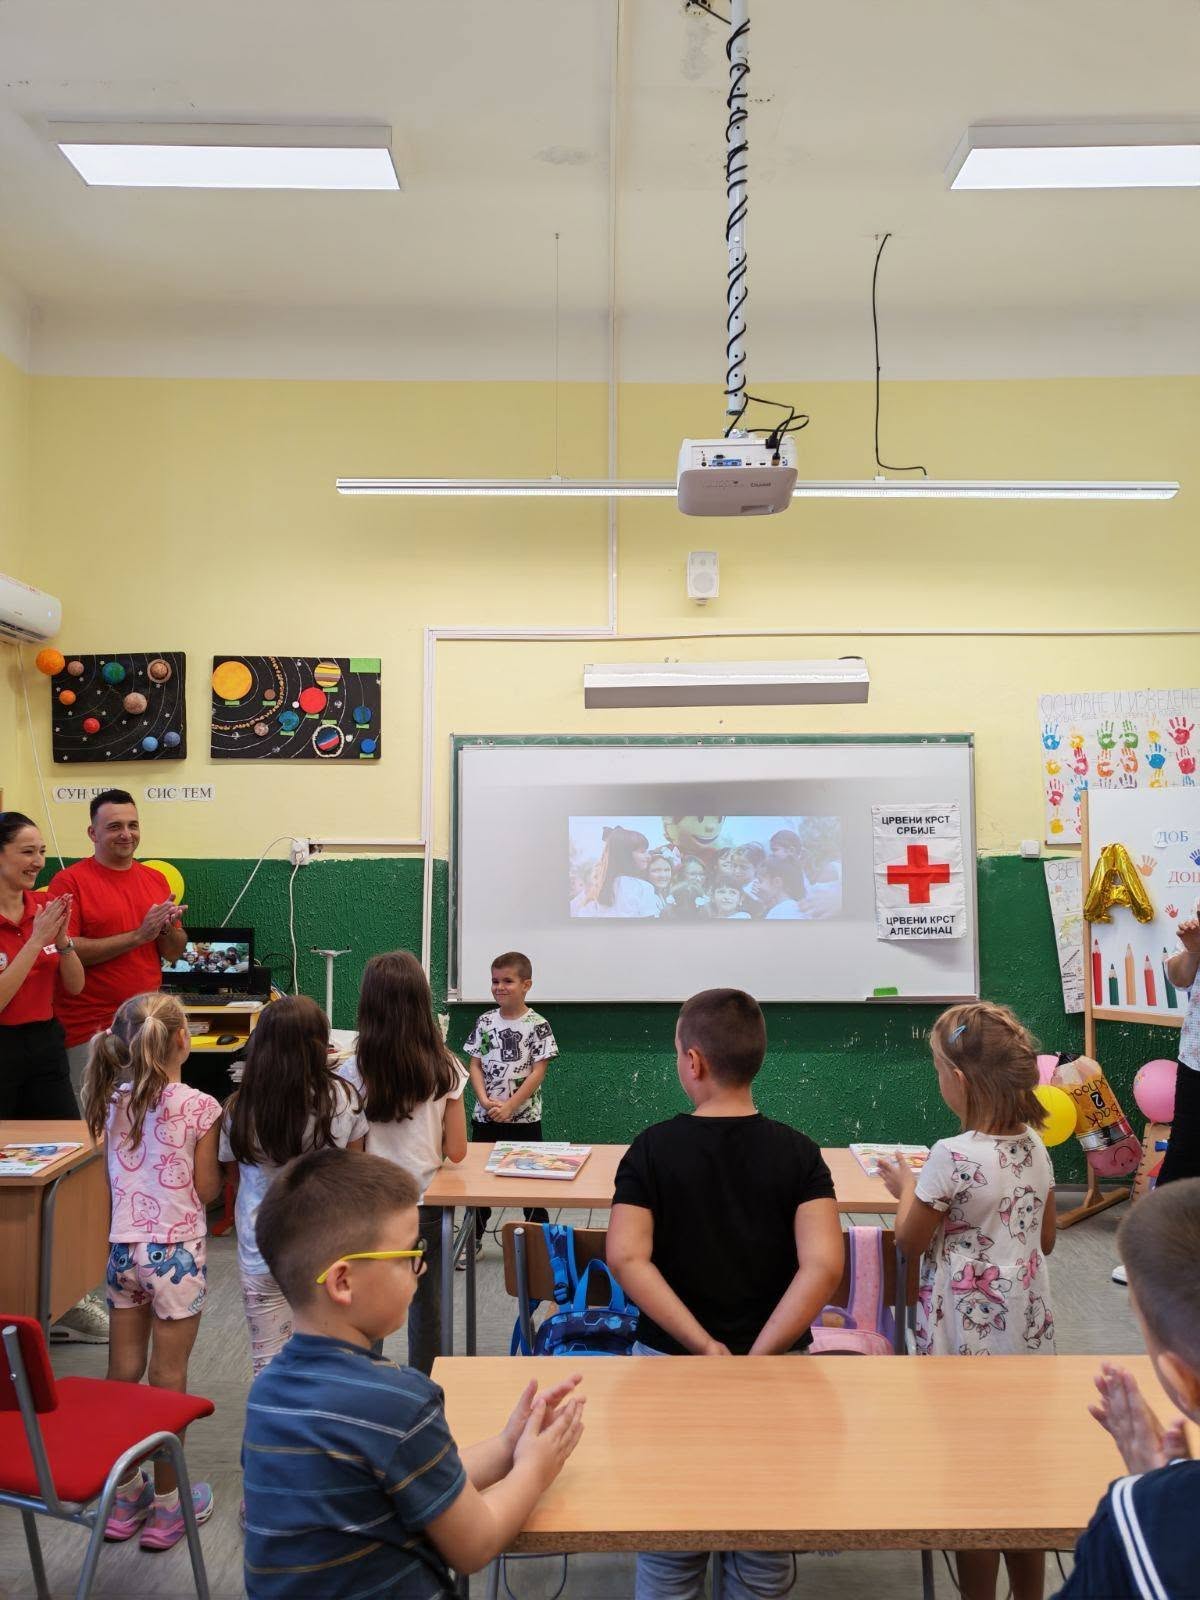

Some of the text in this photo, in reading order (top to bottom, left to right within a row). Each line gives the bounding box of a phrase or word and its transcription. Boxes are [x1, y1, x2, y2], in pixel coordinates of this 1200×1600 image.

[881, 815, 950, 826] ЦРВЕНИ КРСТ
[896, 826, 936, 835] СРБИЈЕ
[886, 915, 956, 926] ЦРВЕНИ КРСТ
[889, 926, 953, 936] АЛЕКСИНАЦ
